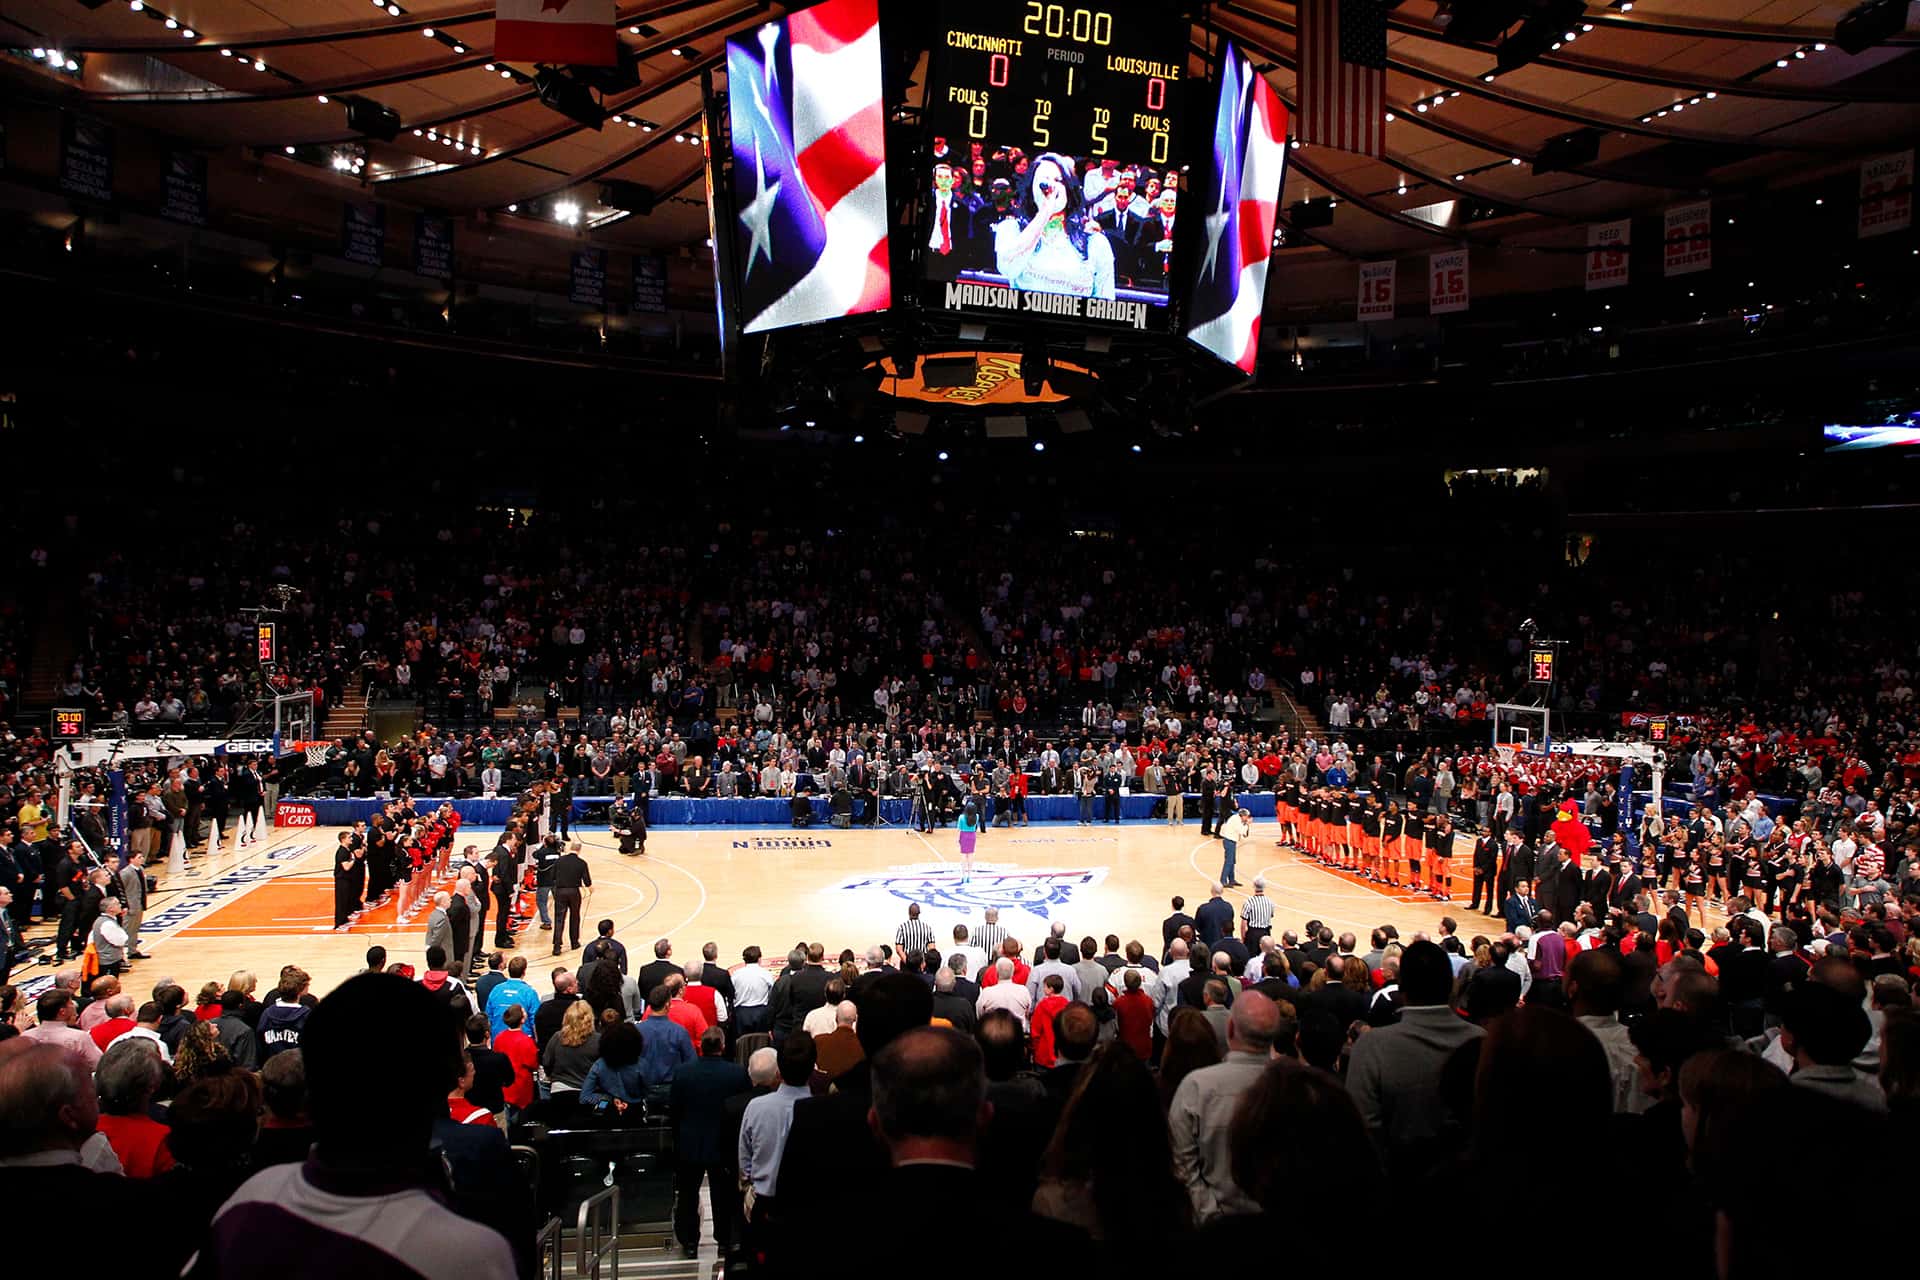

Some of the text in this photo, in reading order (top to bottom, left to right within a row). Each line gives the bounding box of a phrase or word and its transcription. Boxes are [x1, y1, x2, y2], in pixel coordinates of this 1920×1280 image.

[1024, 1, 1112, 45] 20:00
[947, 31, 1022, 56] CINCINNATI
[1047, 48, 1084, 63] PERIOD
[990, 54, 1009, 87] 0
[1107, 55, 1180, 80] LOUISVILLE
[1067, 66, 1074, 96] 1
[949, 87, 988, 106] FOULS
[1147, 78, 1165, 110] 0
[1035, 99, 1052, 115] TO
[1094, 107, 1110, 124] TO
[969, 105, 987, 138] 0
[1033, 114, 1050, 147] 5
[1133, 113, 1170, 132] FOULS
[1091, 122, 1108, 156] 5
[1151, 132, 1169, 163] 0
[1361, 279, 1391, 303] 15
[1435, 269, 1464, 296] 15
[944, 282, 1148, 329] MADISON SQUARE GARDEN
[1536, 664, 1550, 679] 35
[61, 723, 78, 734] 35
[288, 815, 313, 825] CATS
